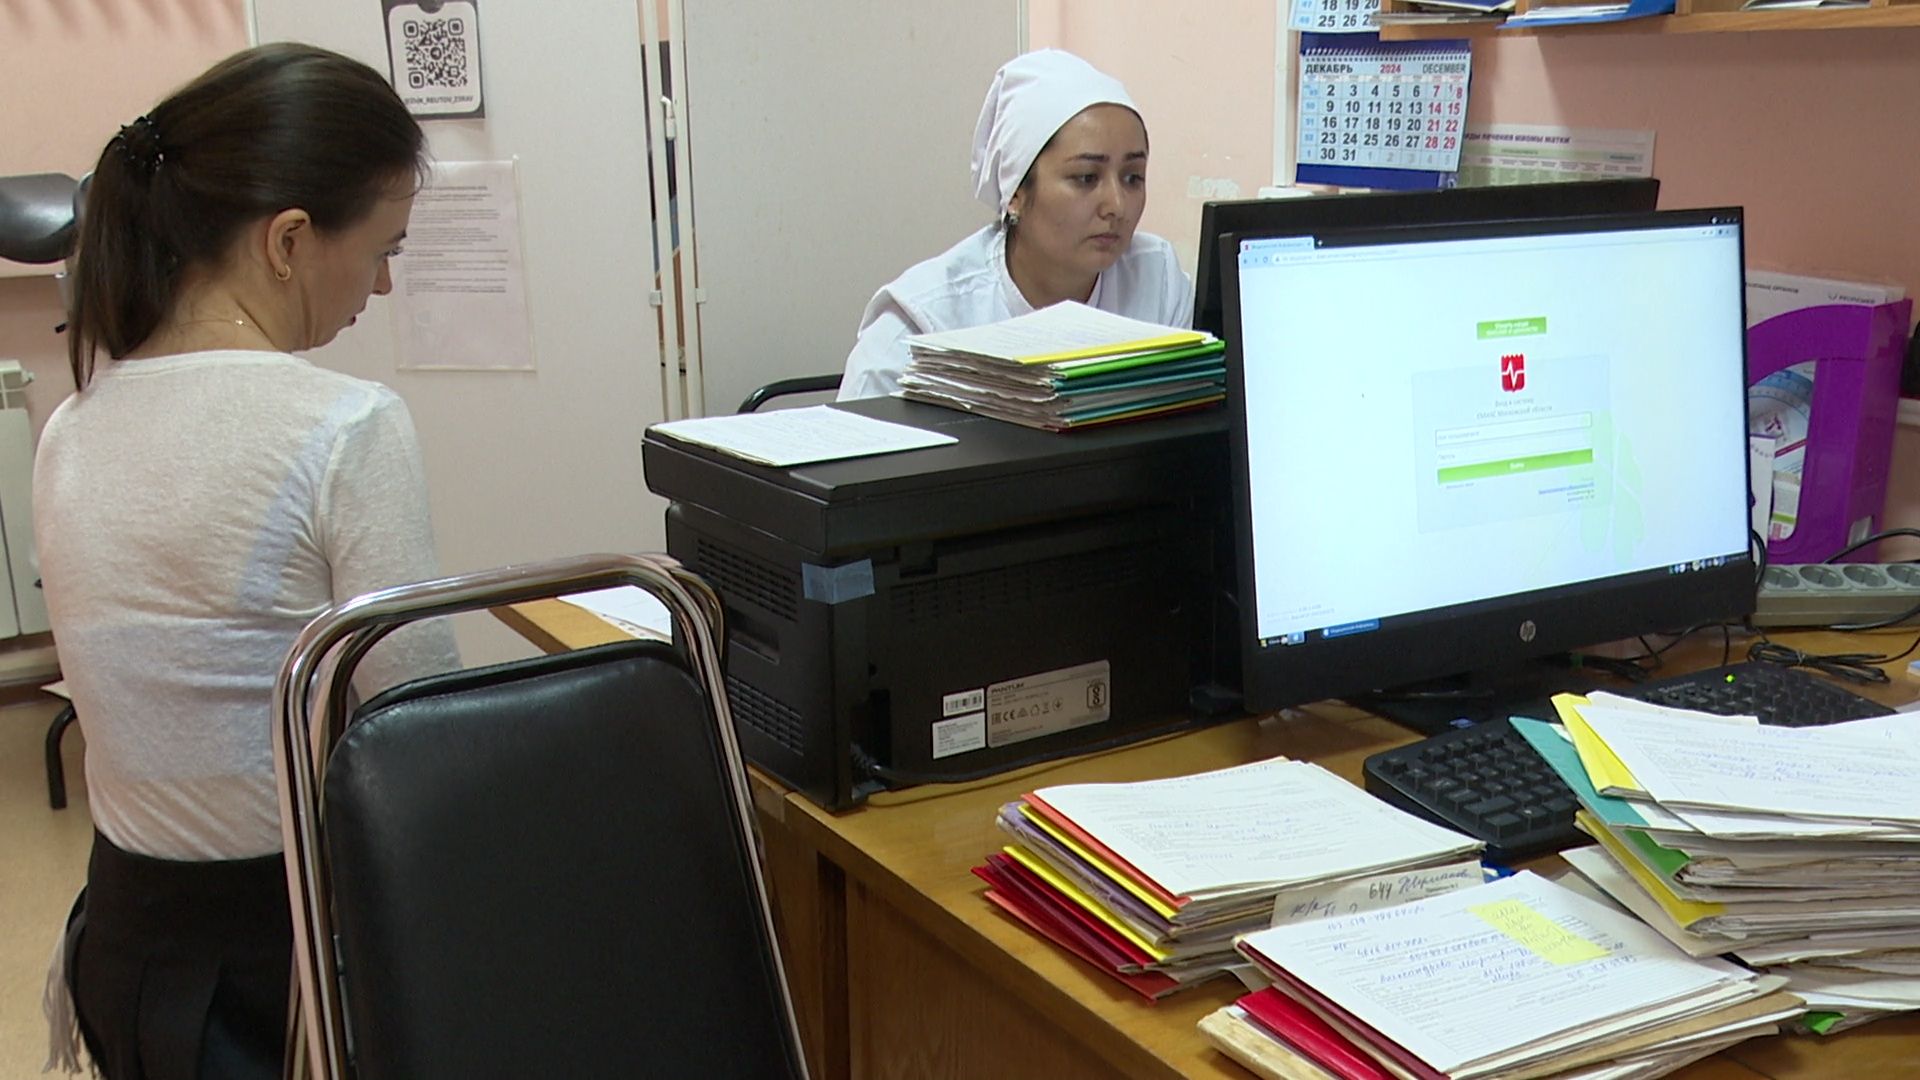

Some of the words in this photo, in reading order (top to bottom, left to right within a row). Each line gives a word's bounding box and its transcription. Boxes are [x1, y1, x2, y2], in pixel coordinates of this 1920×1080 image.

[1322, 0, 1338, 11] 18
[1346, 0, 1360, 10] 19
[1364, 0, 1379, 9] 20
[1318, 15, 1336, 27] 25
[1343, 15, 1358, 27] 26
[1305, 64, 1353, 74] ДЕКАБРЬ
[1380, 64, 1401, 74] 2024
[1422, 63, 1466, 74] DECEMBER
[1327, 84, 1335, 96] 2
[1350, 84, 1358, 97] 3
[1371, 85, 1379, 97] 4
[1393, 85, 1400, 97] 5
[1413, 85, 1420, 97] 6
[1433, 85, 1440, 97] 7
[1456, 87, 1463, 99] 8
[1326, 101, 1335, 112] 9
[1345, 101, 1361, 113] 10
[1368, 101, 1381, 113] 11
[1389, 102, 1402, 114] 12
[1409, 102, 1422, 114] 13
[1428, 103, 1441, 115] 14
[1448, 103, 1461, 115] 15
[1322, 116, 1337, 128] 16
[1344, 117, 1359, 129] 17
[1366, 117, 1380, 130] 18
[1387, 118, 1401, 131] 19
[1407, 118, 1421, 131] 20
[1427, 119, 1440, 132] 21
[1445, 120, 1459, 132] 22
[1321, 132, 1337, 144] 23
[1343, 133, 1358, 145] 24
[1364, 134, 1379, 146] 25
[1384, 134, 1400, 147] 26
[1406, 135, 1420, 148] 27
[1425, 136, 1439, 149] 28
[1443, 136, 1456, 149] 29
[1464, 133, 1481, 141] ИДЫ
[1320, 148, 1336, 160] 30
[1342, 149, 1356, 161] 31
